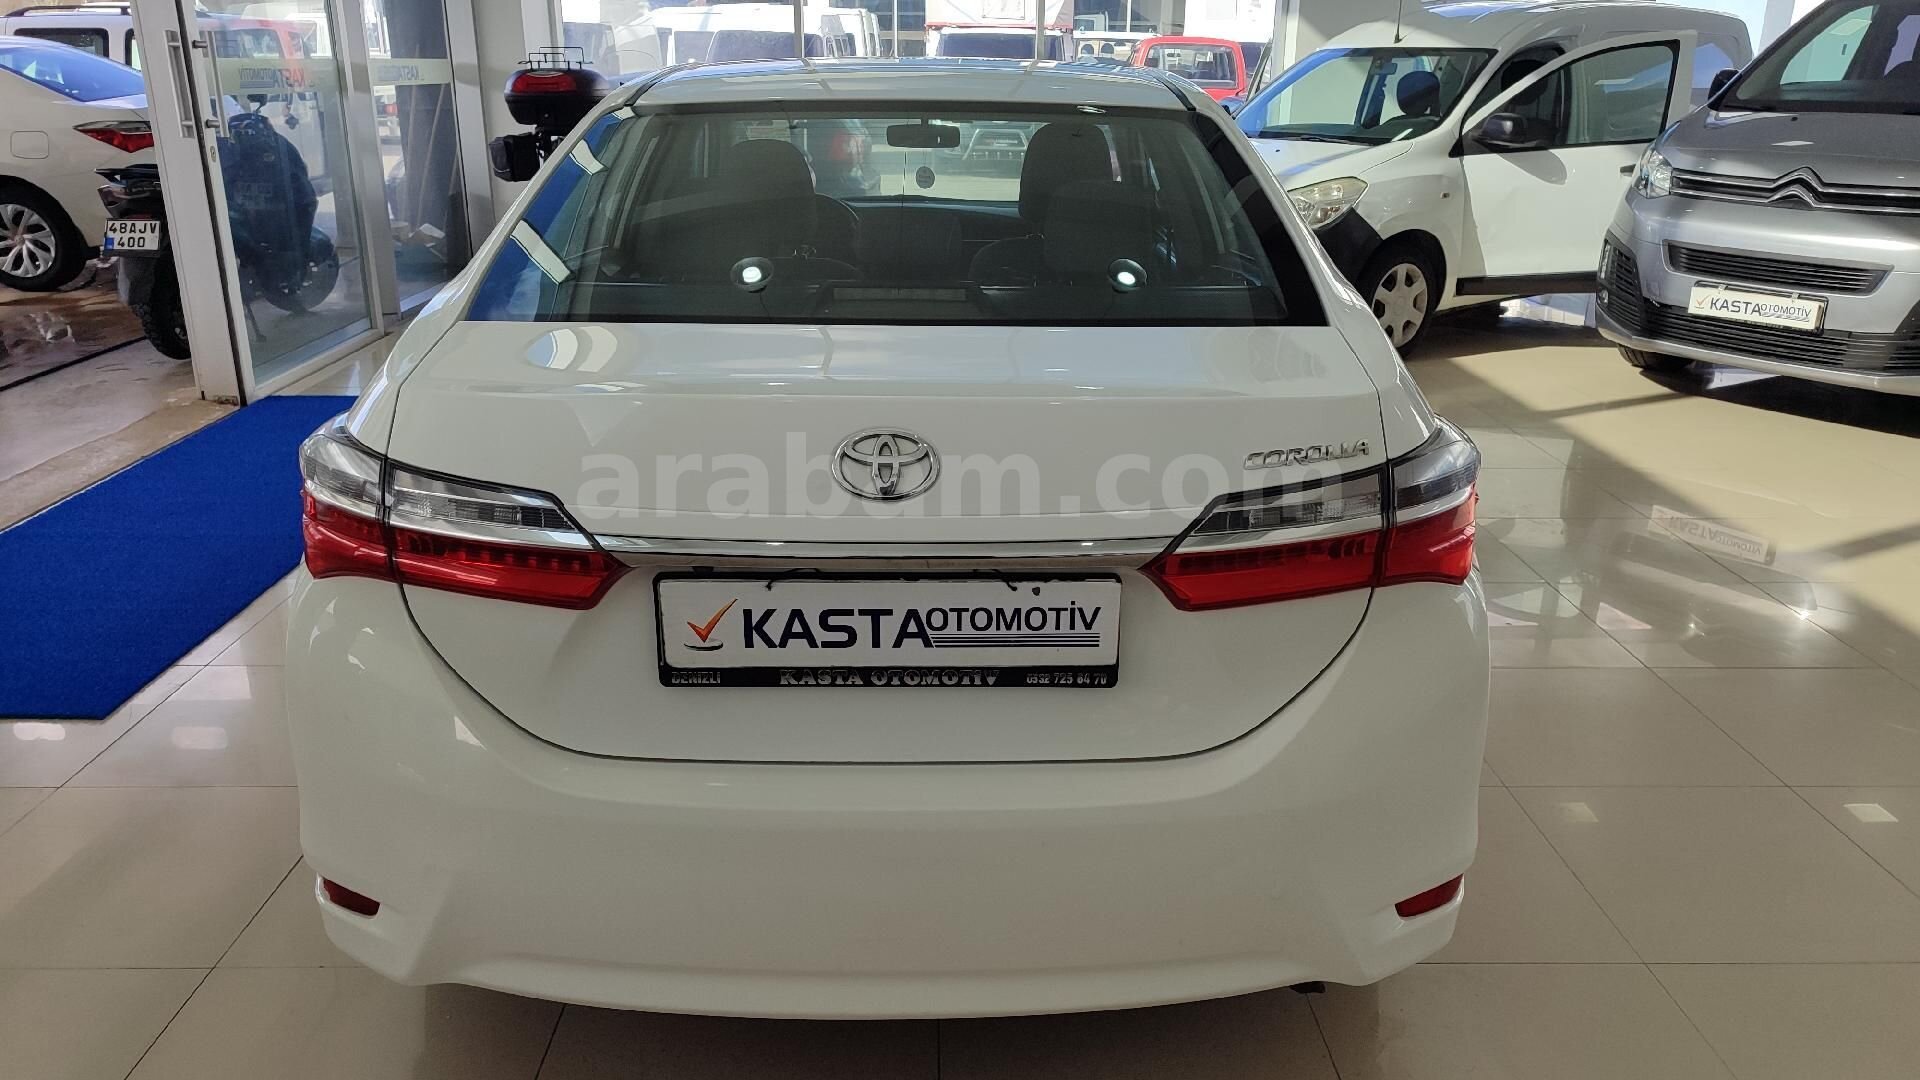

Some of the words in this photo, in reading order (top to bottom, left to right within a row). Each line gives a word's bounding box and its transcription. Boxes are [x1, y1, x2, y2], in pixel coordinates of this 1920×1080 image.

[109, 222, 157, 234] 48AJV
[117, 236, 145, 248] 400
[1244, 438, 1370, 471] COROLLA
[779, 669, 864, 686] KASTA
[870, 669, 1000, 686] OTOMOTİV
[1053, 672, 1074, 684] 725
